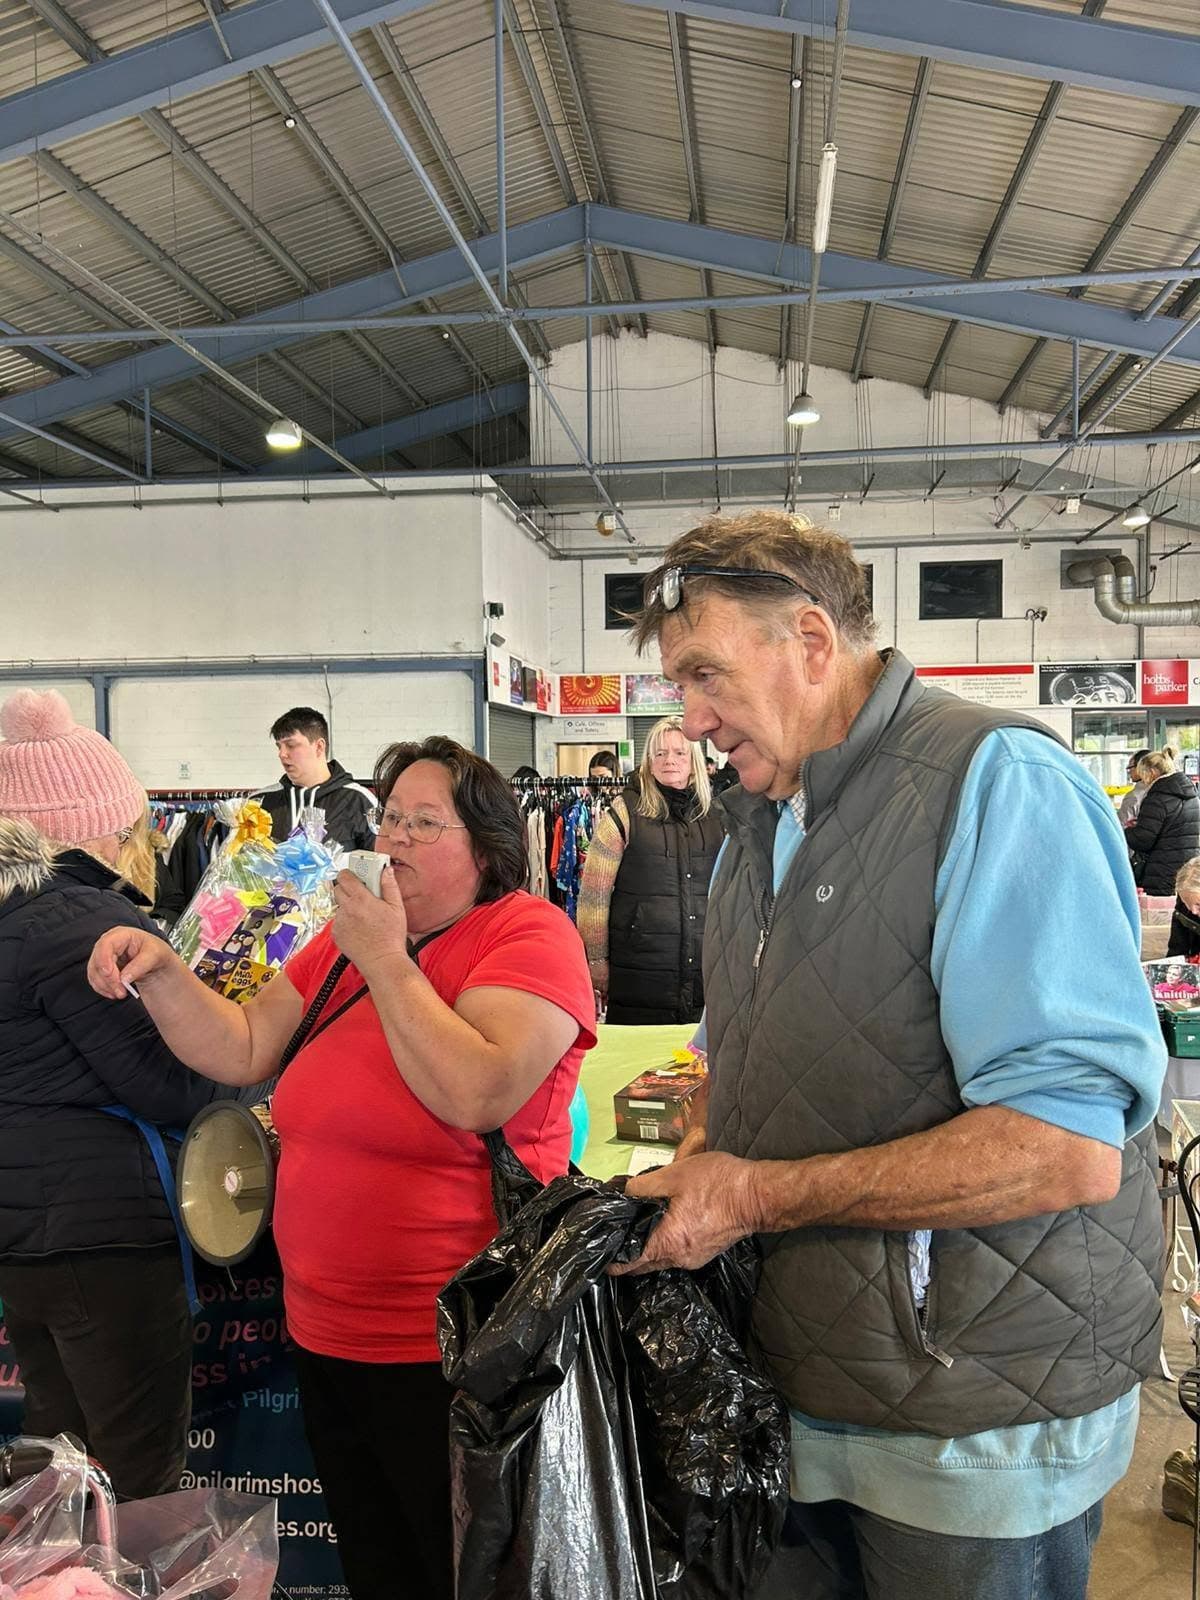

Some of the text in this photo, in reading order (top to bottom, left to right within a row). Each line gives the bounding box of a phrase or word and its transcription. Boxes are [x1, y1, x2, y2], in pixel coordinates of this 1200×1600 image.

[1154, 682, 1187, 695] parker
[241, 1387, 300, 1414] Pilgri
[187, 1428, 215, 1450] 00
[289, 1584, 327, 1595] number:
